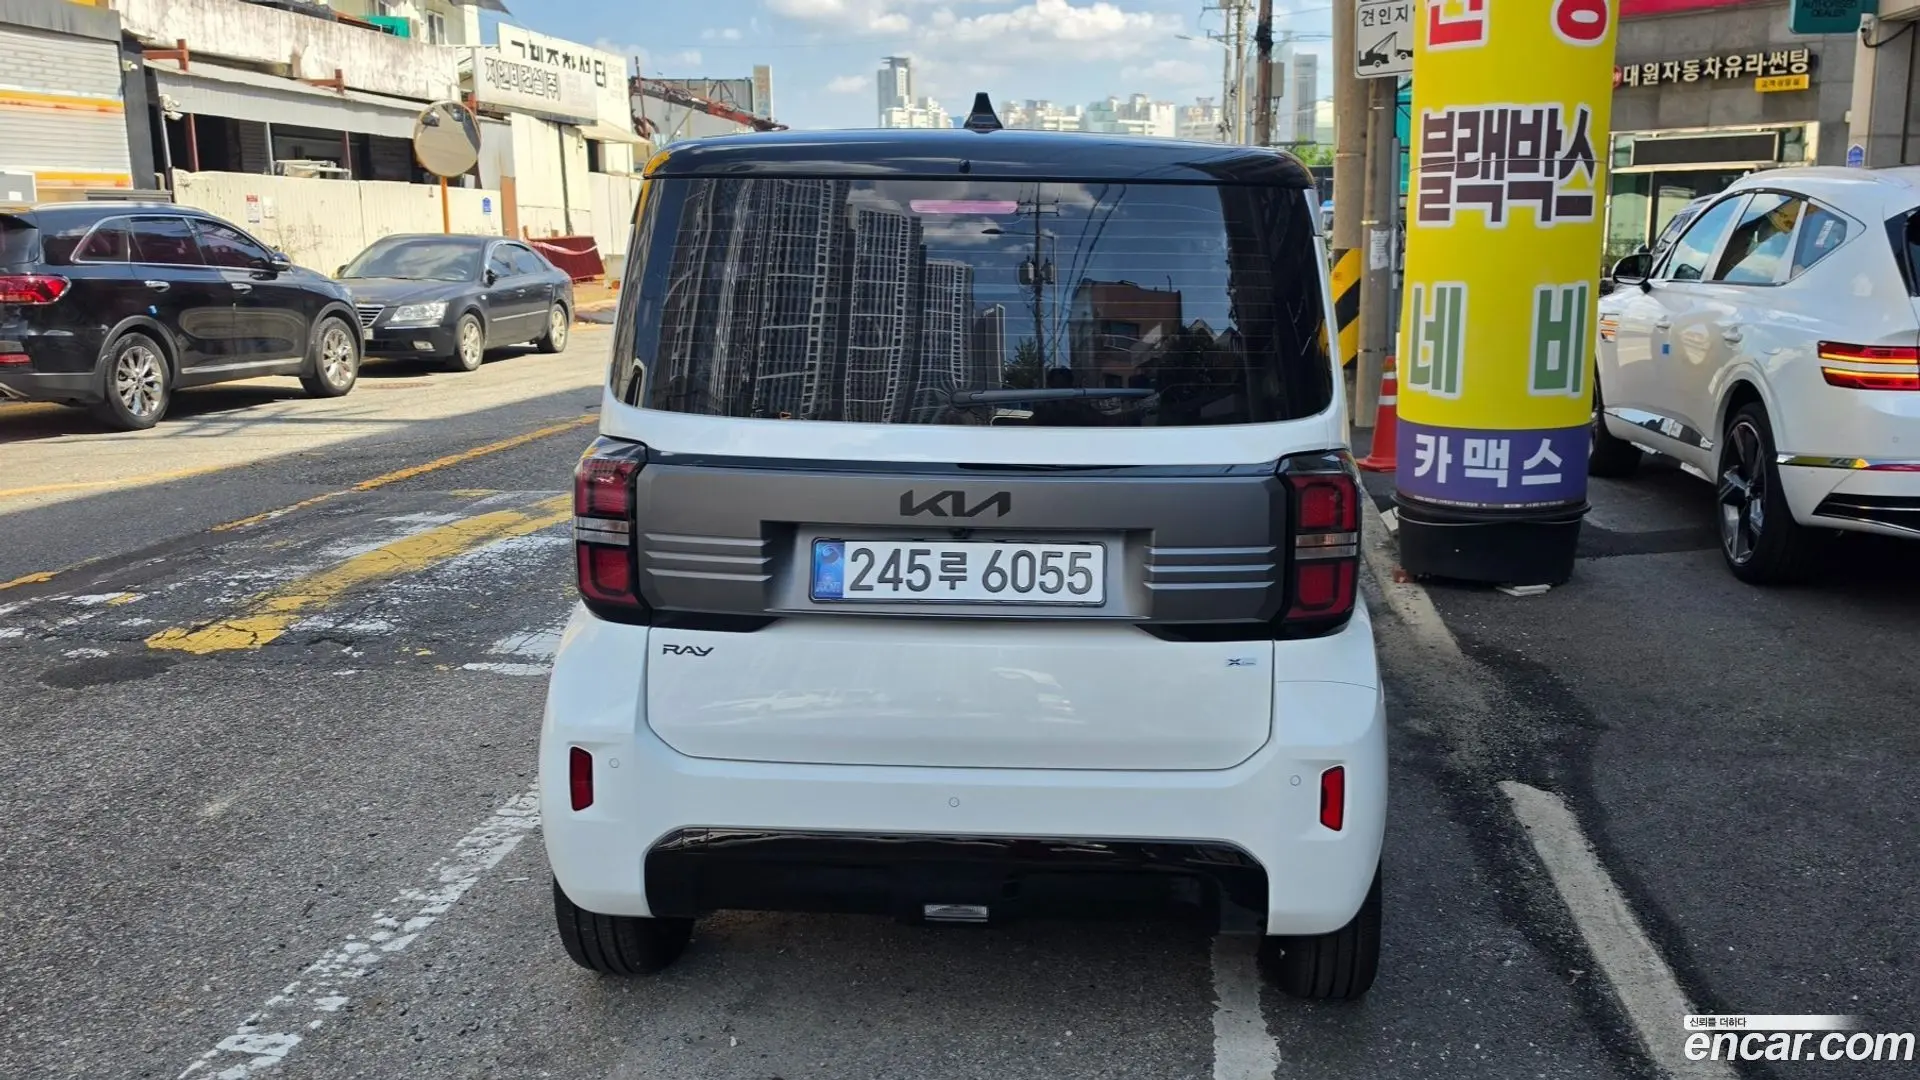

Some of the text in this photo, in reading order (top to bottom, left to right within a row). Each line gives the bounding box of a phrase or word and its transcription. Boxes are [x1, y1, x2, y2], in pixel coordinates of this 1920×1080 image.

[1361, 4, 1416, 27] 견인지
[1418, 107, 1596, 223] 블랙박스
[1413, 432, 1563, 488] 카맥스
[899, 489, 1011, 517] KIA
[849, 547, 1093, 595] 245루 6055
[663, 644, 714, 656] RAY
